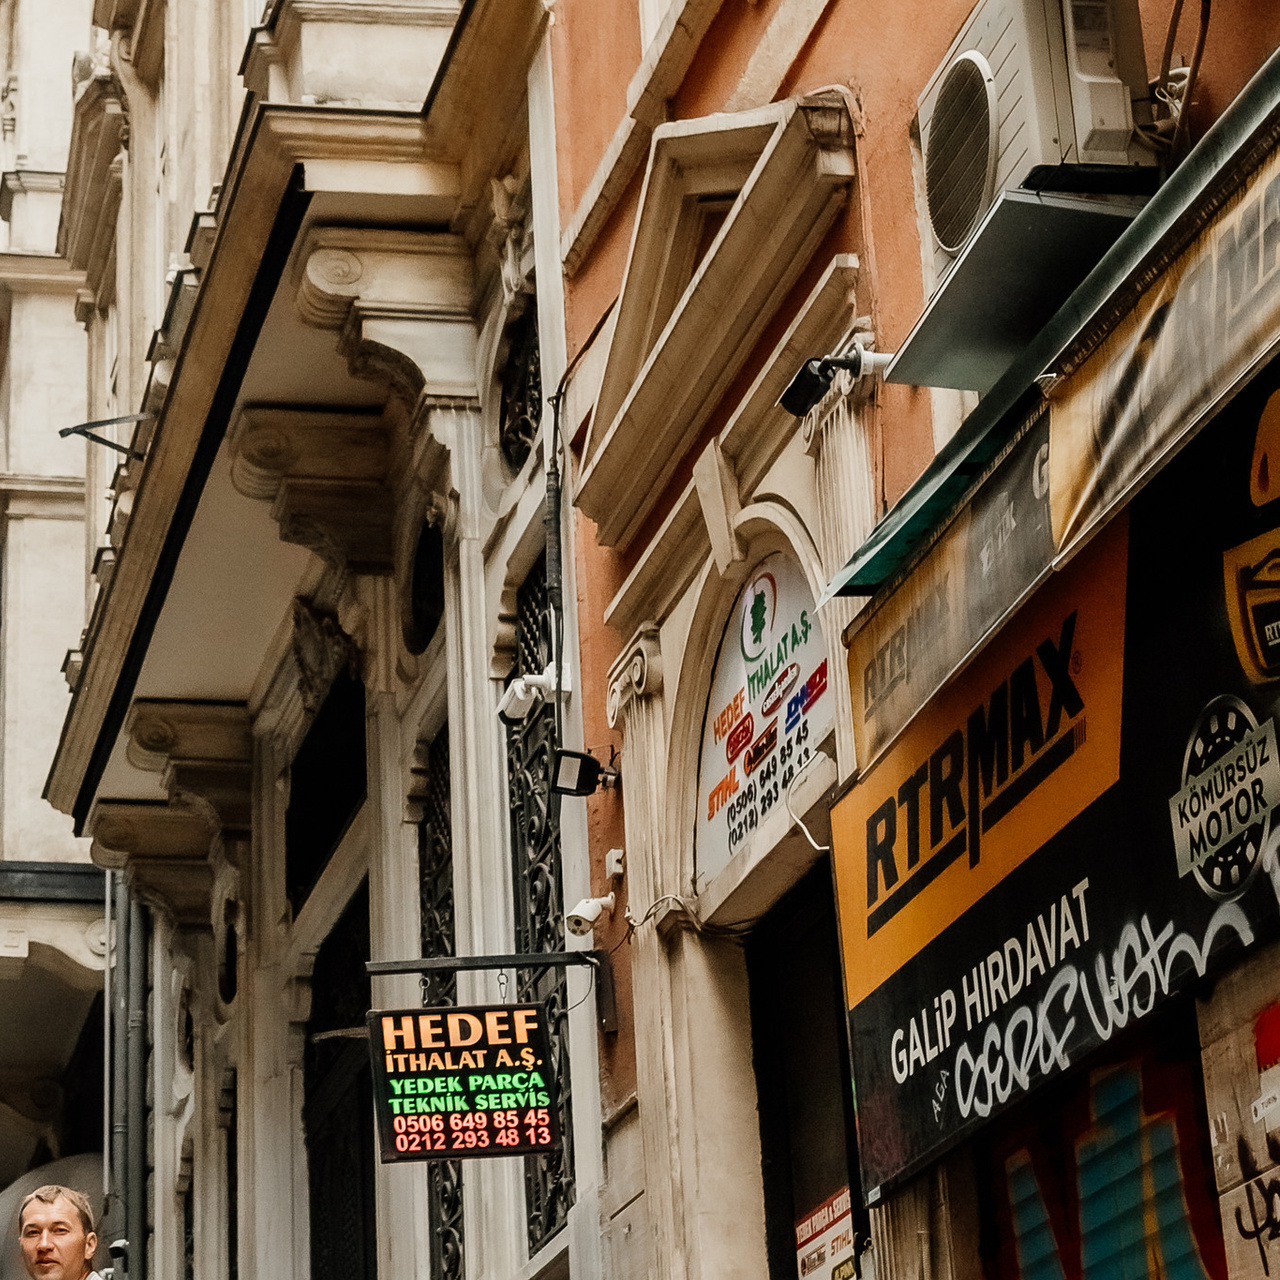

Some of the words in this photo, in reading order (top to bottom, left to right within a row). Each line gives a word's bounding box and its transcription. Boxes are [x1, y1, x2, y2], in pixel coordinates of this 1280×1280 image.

[708, 765, 739, 821] STIHL
[784, 657, 828, 726] JOHNSON
[713, 686, 745, 745] HEDEF
[727, 778, 757, 830] (0506)
[759, 754, 778, 789] 649
[780, 736, 793, 766] 85
[795, 718, 809, 746] 45
[867, 610, 1085, 910] RTRMAX
[1178, 735, 1270, 828] KÖMÜRSÜZ
[728, 804, 758, 855] (0212)
[760, 780, 779, 816] 293
[1189, 777, 1268, 863] MOTOR
[962, 878, 1090, 1032] HIRDAVAT
[381, 1009, 539, 1050] HEDEF
[385, 1049, 487, 1073] İTHALAT
[495, 1047, 543, 1071] A.Ş.
[389, 1076, 463, 1095] YEDEK
[469, 1072, 545, 1093] PARÇA
[388, 1093, 469, 1114] TEKNİK
[475, 1090, 551, 1111] SERVİS
[393, 1114, 444, 1134] 0506
[449, 1111, 487, 1131] 649
[493, 1109, 519, 1129] 85
[523, 1108, 550, 1127] 45
[395, 1132, 446, 1152] 0212
[451, 1130, 490, 1149] 293
[495, 1128, 520, 1147] 48
[525, 1126, 552, 1145] 13
[830, 1229, 852, 1257] STIHL
